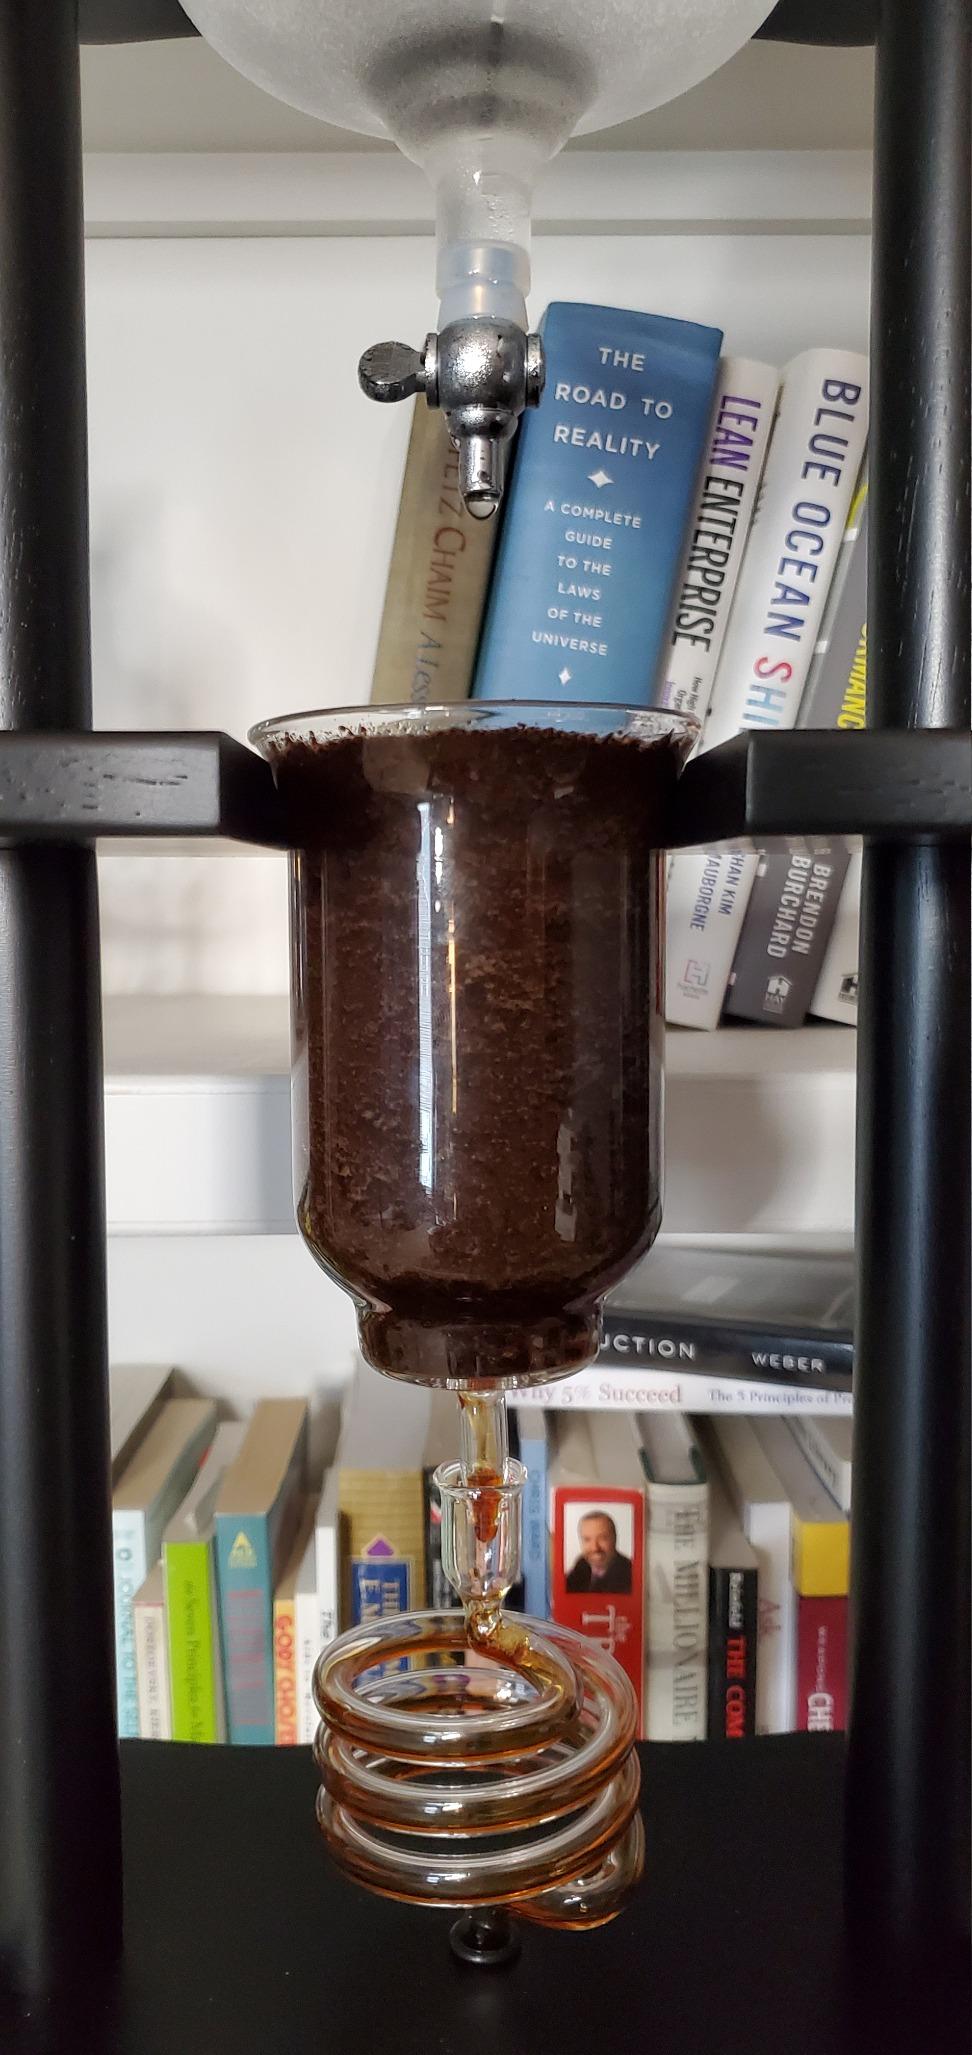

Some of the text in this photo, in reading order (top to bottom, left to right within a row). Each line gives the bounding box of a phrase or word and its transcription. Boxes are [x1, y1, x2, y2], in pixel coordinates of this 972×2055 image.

[599, 347, 646, 372] THE
[555, 383, 673, 419] ROAD TO
[553, 424, 661, 460] REALITY
[800, 379, 862, 487] BLUE
[544, 501, 642, 528] A COMPLETE
[672, 395, 761, 653] LEAN ENTERPRISE
[565, 530, 613, 549] GUIDE
[423, 527, 466, 622] CHAIM
[558, 555, 612, 576] TO THE
[763, 501, 831, 642] OCEAN
[558, 582, 601, 601] LAWS
[547, 607, 603, 628] OF THE
[532, 631, 608, 656] UNIVERSE
[718, 889, 736, 915] KIM
[767, 855, 812, 959] BURCHARD
[791, 863, 832, 955] BRENDON
[751, 1351, 824, 1373] WEBER
[598, 1381, 681, 1404] Succeed
[711, 1388, 733, 1402] The
[750, 1391, 814, 1406] Principles
[673, 1560, 699, 1726] MILLIONAIRE
[727, 1636, 745, 1679] THE
[726, 1685, 744, 1738] COM
